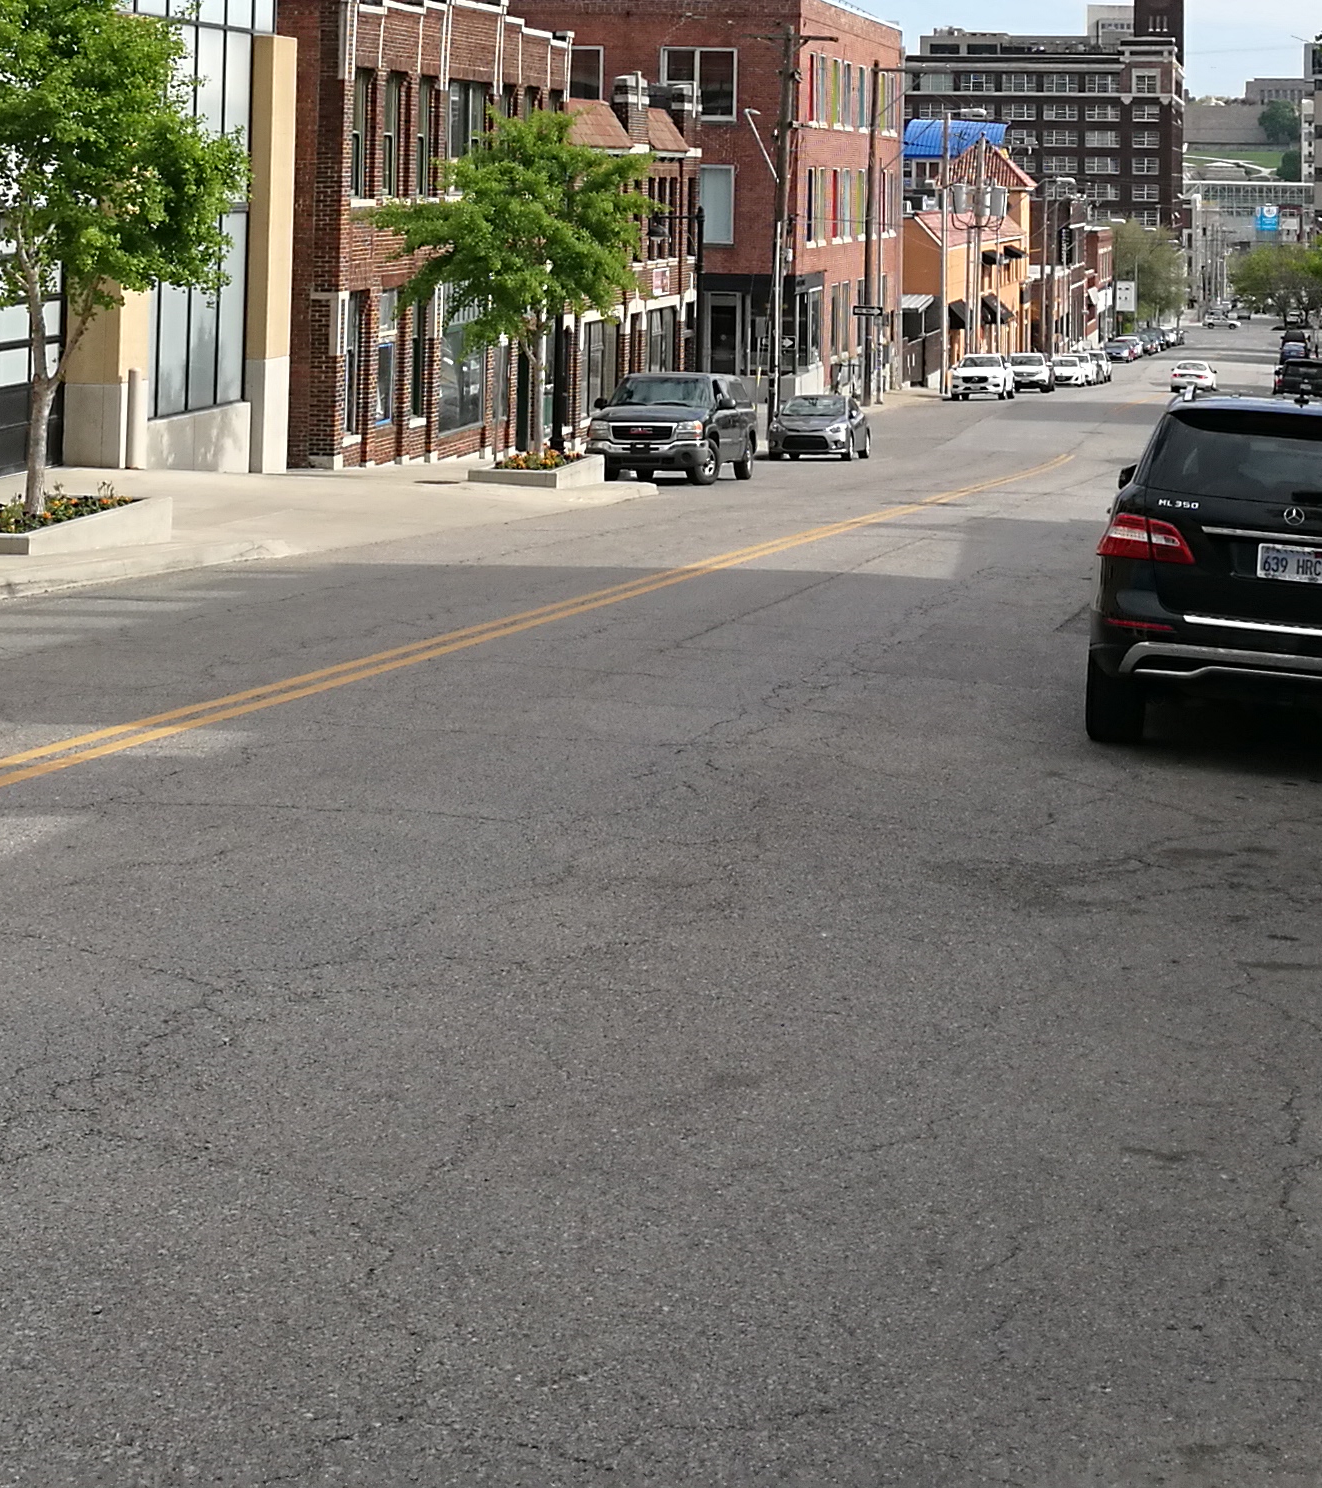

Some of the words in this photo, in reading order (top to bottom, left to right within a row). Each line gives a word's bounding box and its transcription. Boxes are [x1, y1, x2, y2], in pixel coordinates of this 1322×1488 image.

[1174, 500, 1200, 510] 350
[1263, 555, 1289, 574] 639
[1295, 558, 1322, 577] HRC
